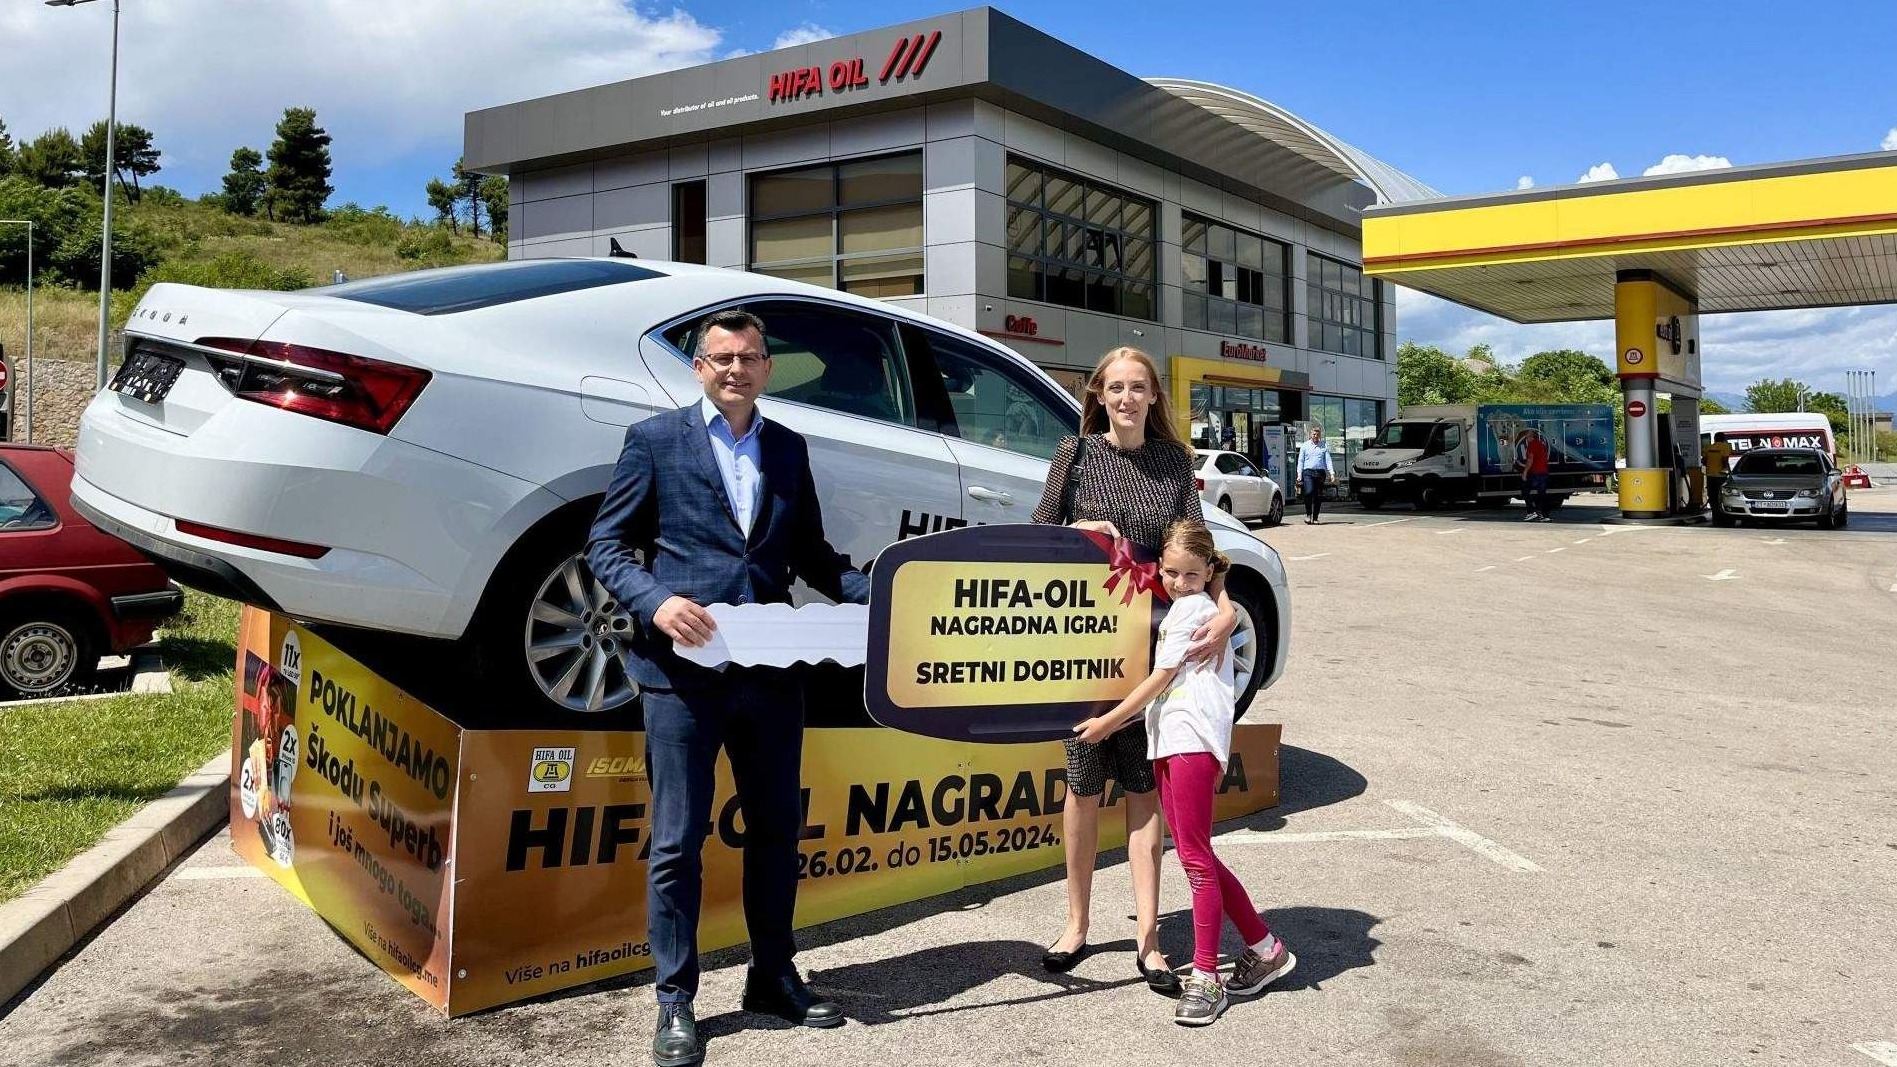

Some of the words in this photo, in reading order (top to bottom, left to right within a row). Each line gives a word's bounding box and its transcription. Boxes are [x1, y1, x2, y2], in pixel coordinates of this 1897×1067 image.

[768, 66, 822, 101] HIFA
[829, 58, 868, 90] OIL
[673, 104, 700, 114] distributor
[700, 102, 707, 110] of
[716, 99, 726, 107] and
[954, 578, 1096, 609] HIFA-OIL
[931, 616, 1058, 636] NAGRADNA
[1064, 614, 1118, 634] IGRA!
[916, 661, 1005, 684] SRETNI
[1013, 658, 1125, 682] DOBITNIK
[310, 669, 450, 800] POKLANJAMO
[535, 750, 555, 761] HIFA
[559, 749, 572, 760] OIL
[306, 721, 364, 807] Škodu
[368, 780, 443, 871] Superb
[333, 815, 353, 852] još
[354, 840, 395, 895] mnogo
[797, 845, 879, 880] 26.02.
[887, 841, 920, 869] do
[928, 823, 1061, 863] 15.05.2024.
[364, 920, 377, 943] Više
[378, 935, 387, 950] na
[388, 941, 438, 988] hifaoilcg.me
[505, 963, 543, 985] Više
[549, 960, 570, 976] na
[576, 941, 653, 970] hifaoilcg
